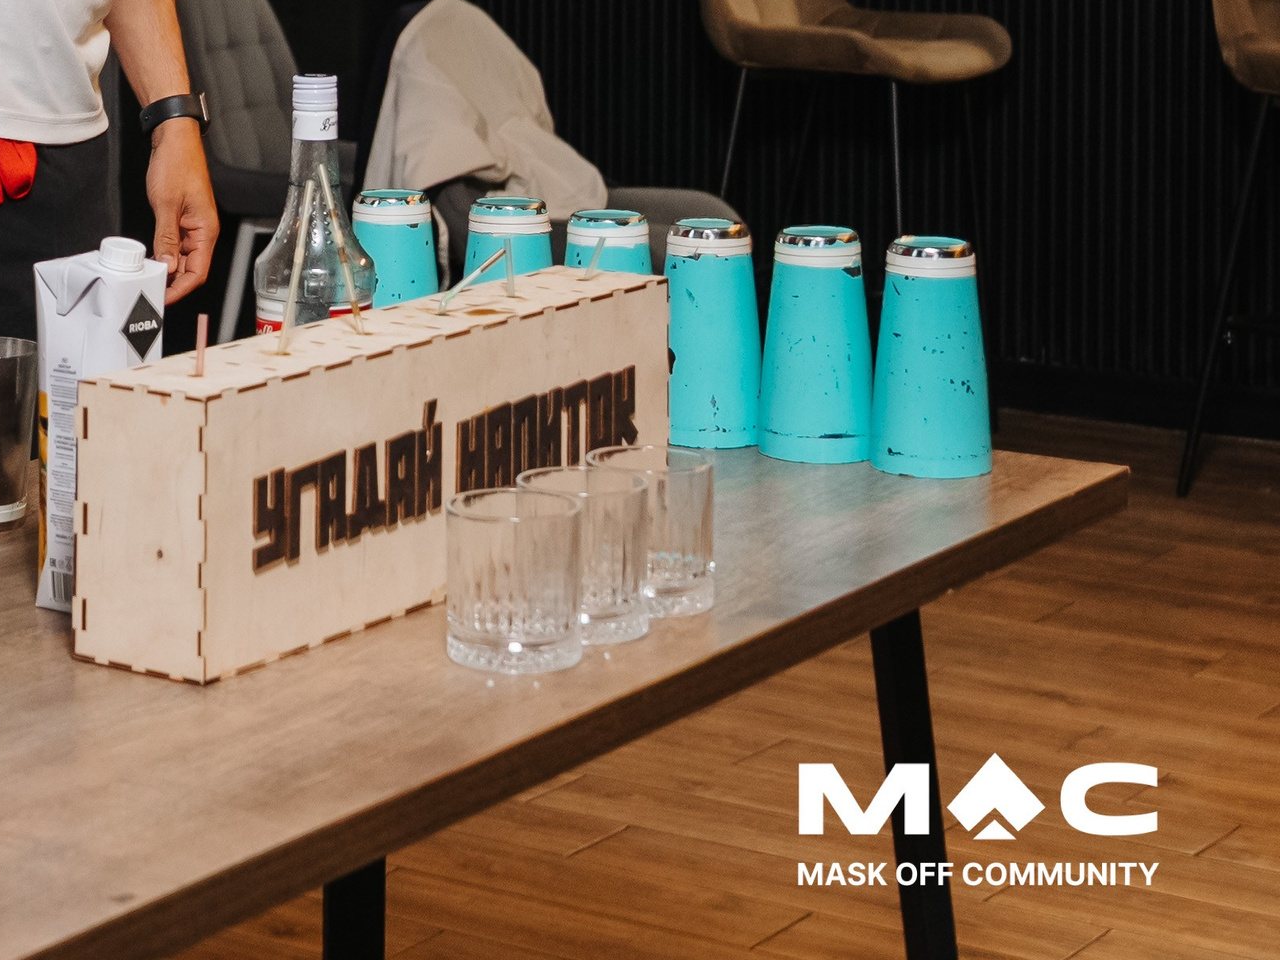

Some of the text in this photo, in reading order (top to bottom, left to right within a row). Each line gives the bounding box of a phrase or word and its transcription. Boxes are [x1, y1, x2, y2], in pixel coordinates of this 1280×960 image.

[129, 319, 158, 333] RIOBA
[252, 364, 639, 575] УГАДАЙ НАПИТОК
